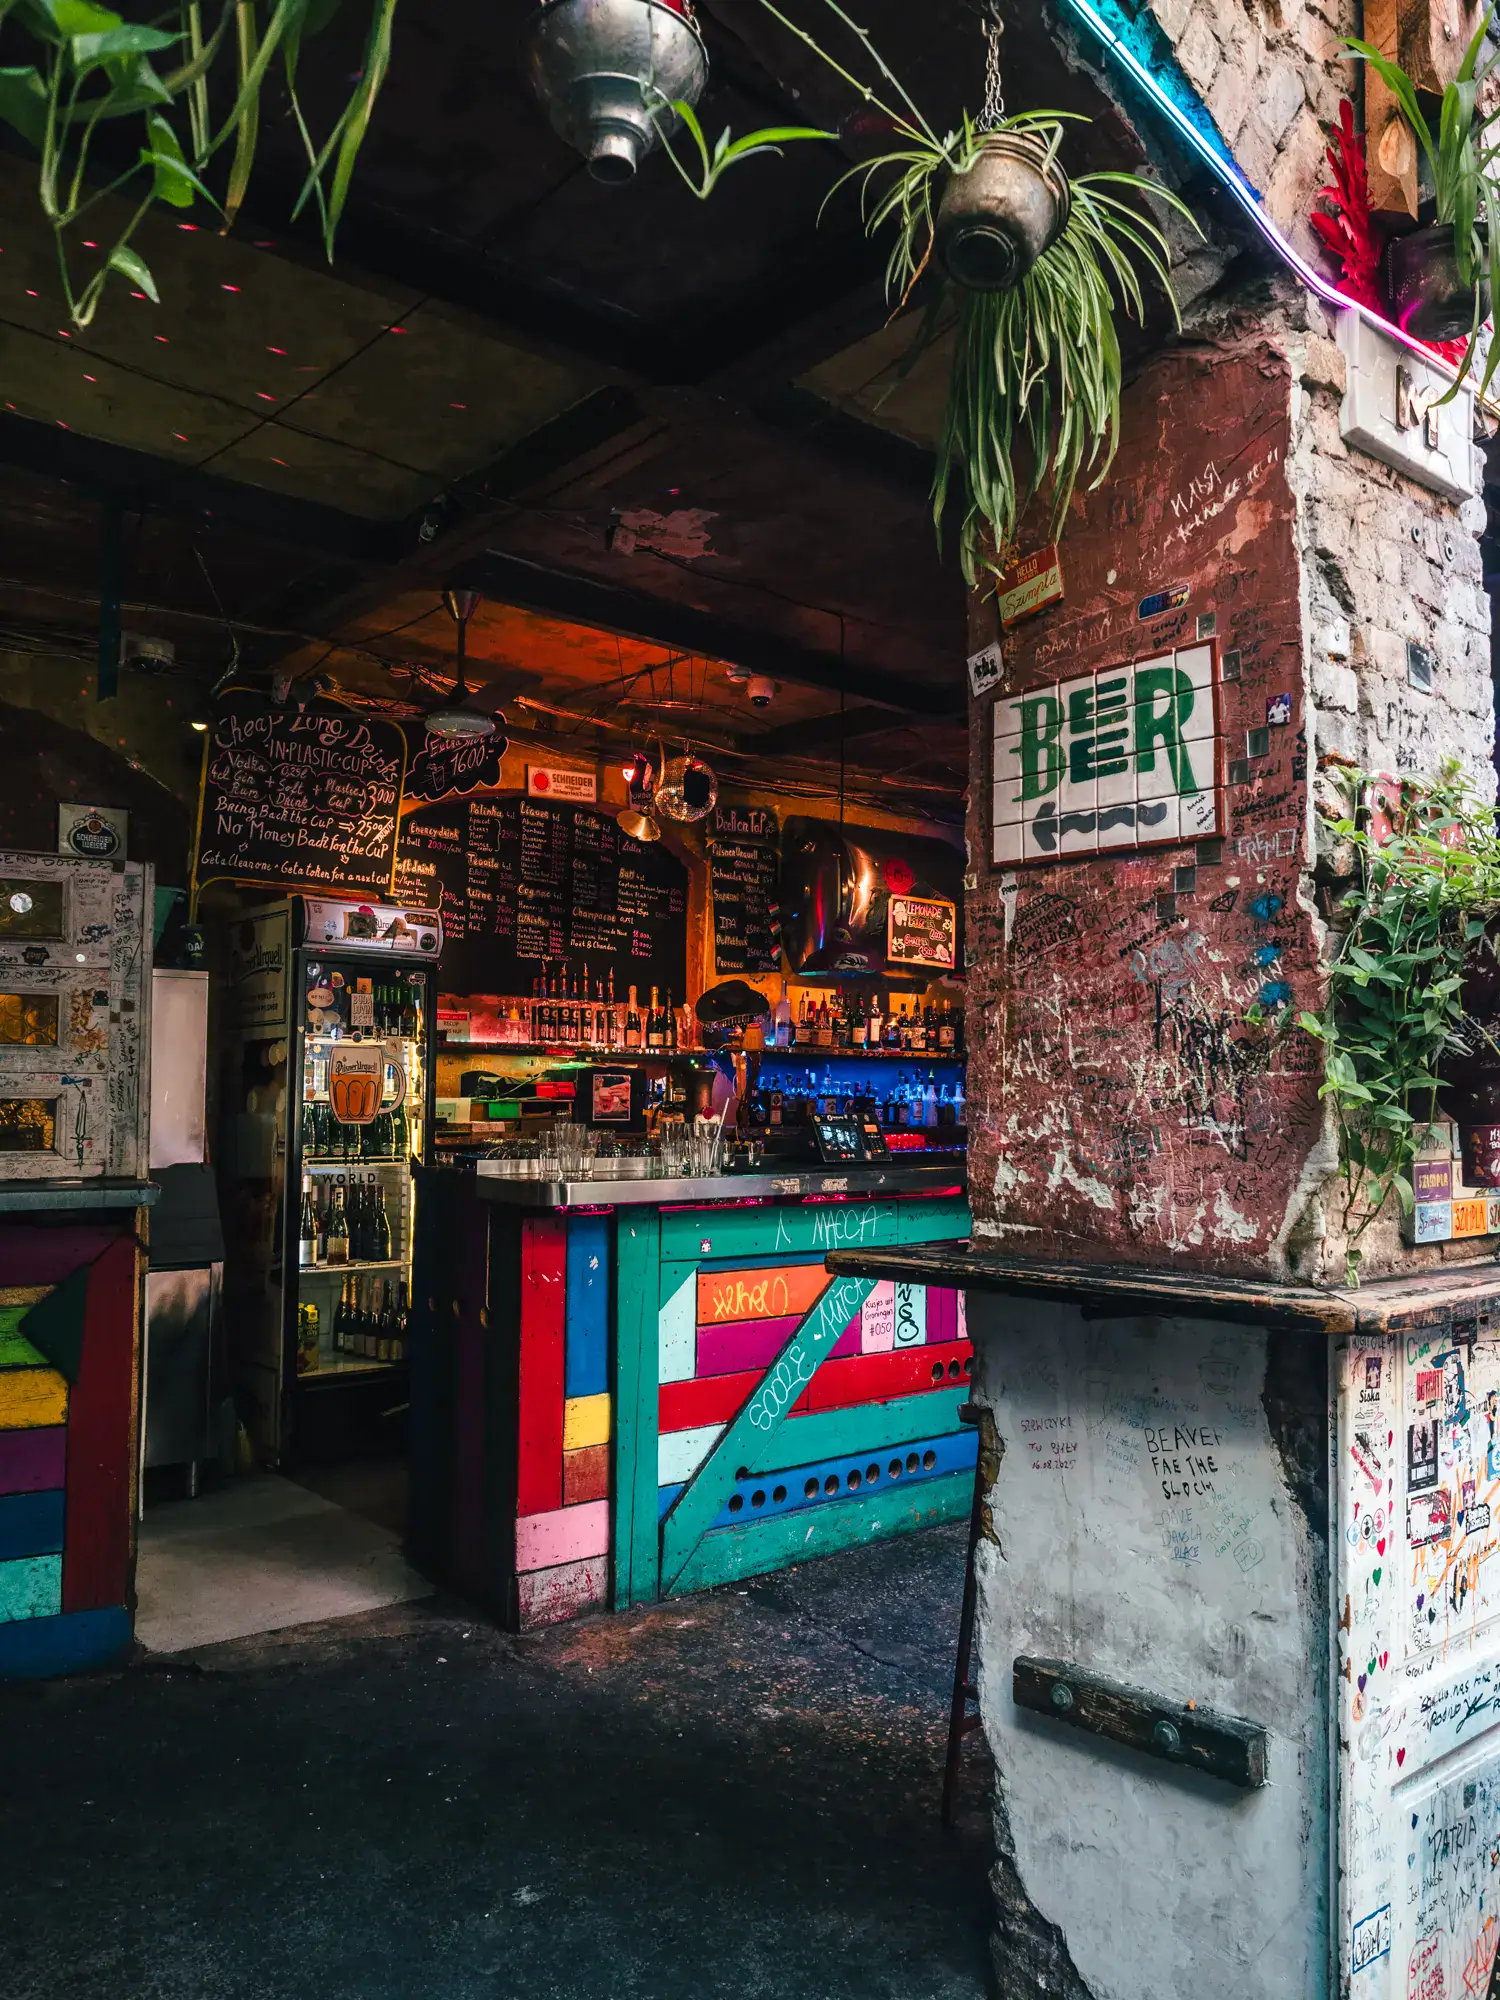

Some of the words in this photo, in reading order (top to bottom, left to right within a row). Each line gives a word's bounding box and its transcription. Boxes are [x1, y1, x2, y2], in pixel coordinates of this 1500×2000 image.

[1016, 559, 1038, 578] HELLO
[1003, 570, 1058, 620] Szimpla
[1009, 667, 1200, 803] BEER
[227, 751, 267, 773] Vodka
[345, 724, 400, 783] Drinks
[234, 769, 255, 785] Gin
[551, 773, 594, 789] SCHNEIDER
[230, 781, 260, 799] Rum
[276, 778, 304, 796] Soft
[276, 792, 309, 808] Drink
[214, 795, 257, 822] Bring
[259, 803, 288, 821] Back
[290, 810, 308, 825] the
[76, 833, 113, 844] SCHNEIDER
[217, 813, 243, 835] No
[249, 820, 295, 847] Money
[297, 828, 329, 848] Back
[346, 836, 365, 855] the
[409, 821, 437, 839] Energy
[438, 825, 461, 841] drink
[412, 859, 437, 878] drink
[466, 851, 499, 869] Tequila
[572, 858, 588, 870] Gin
[305, 862, 330, 880] token
[330, 866, 345, 883] for
[347, 873, 355, 881] a
[355, 870, 375, 883] next
[466, 886, 493, 901] Wine
[517, 882, 551, 900] Cognac
[907, 900, 943, 920] LEMONADE
[468, 922, 482, 932] Red
[719, 915, 738, 929] IPA
[592, 941, 618, 952] Chandon
[352, 1014, 373, 1025] PEST
[322, 1173, 376, 1184] WORLD
[1455, 1203, 1486, 1232] SZIMPLA
[865, 1299, 883, 1311] Kusjes
[869, 1321, 893, 1337] #050
[1359, 1389, 1381, 1403] Siska
[1152, 1456, 1182, 1476] FAE
[1185, 1455, 1218, 1477] THE
